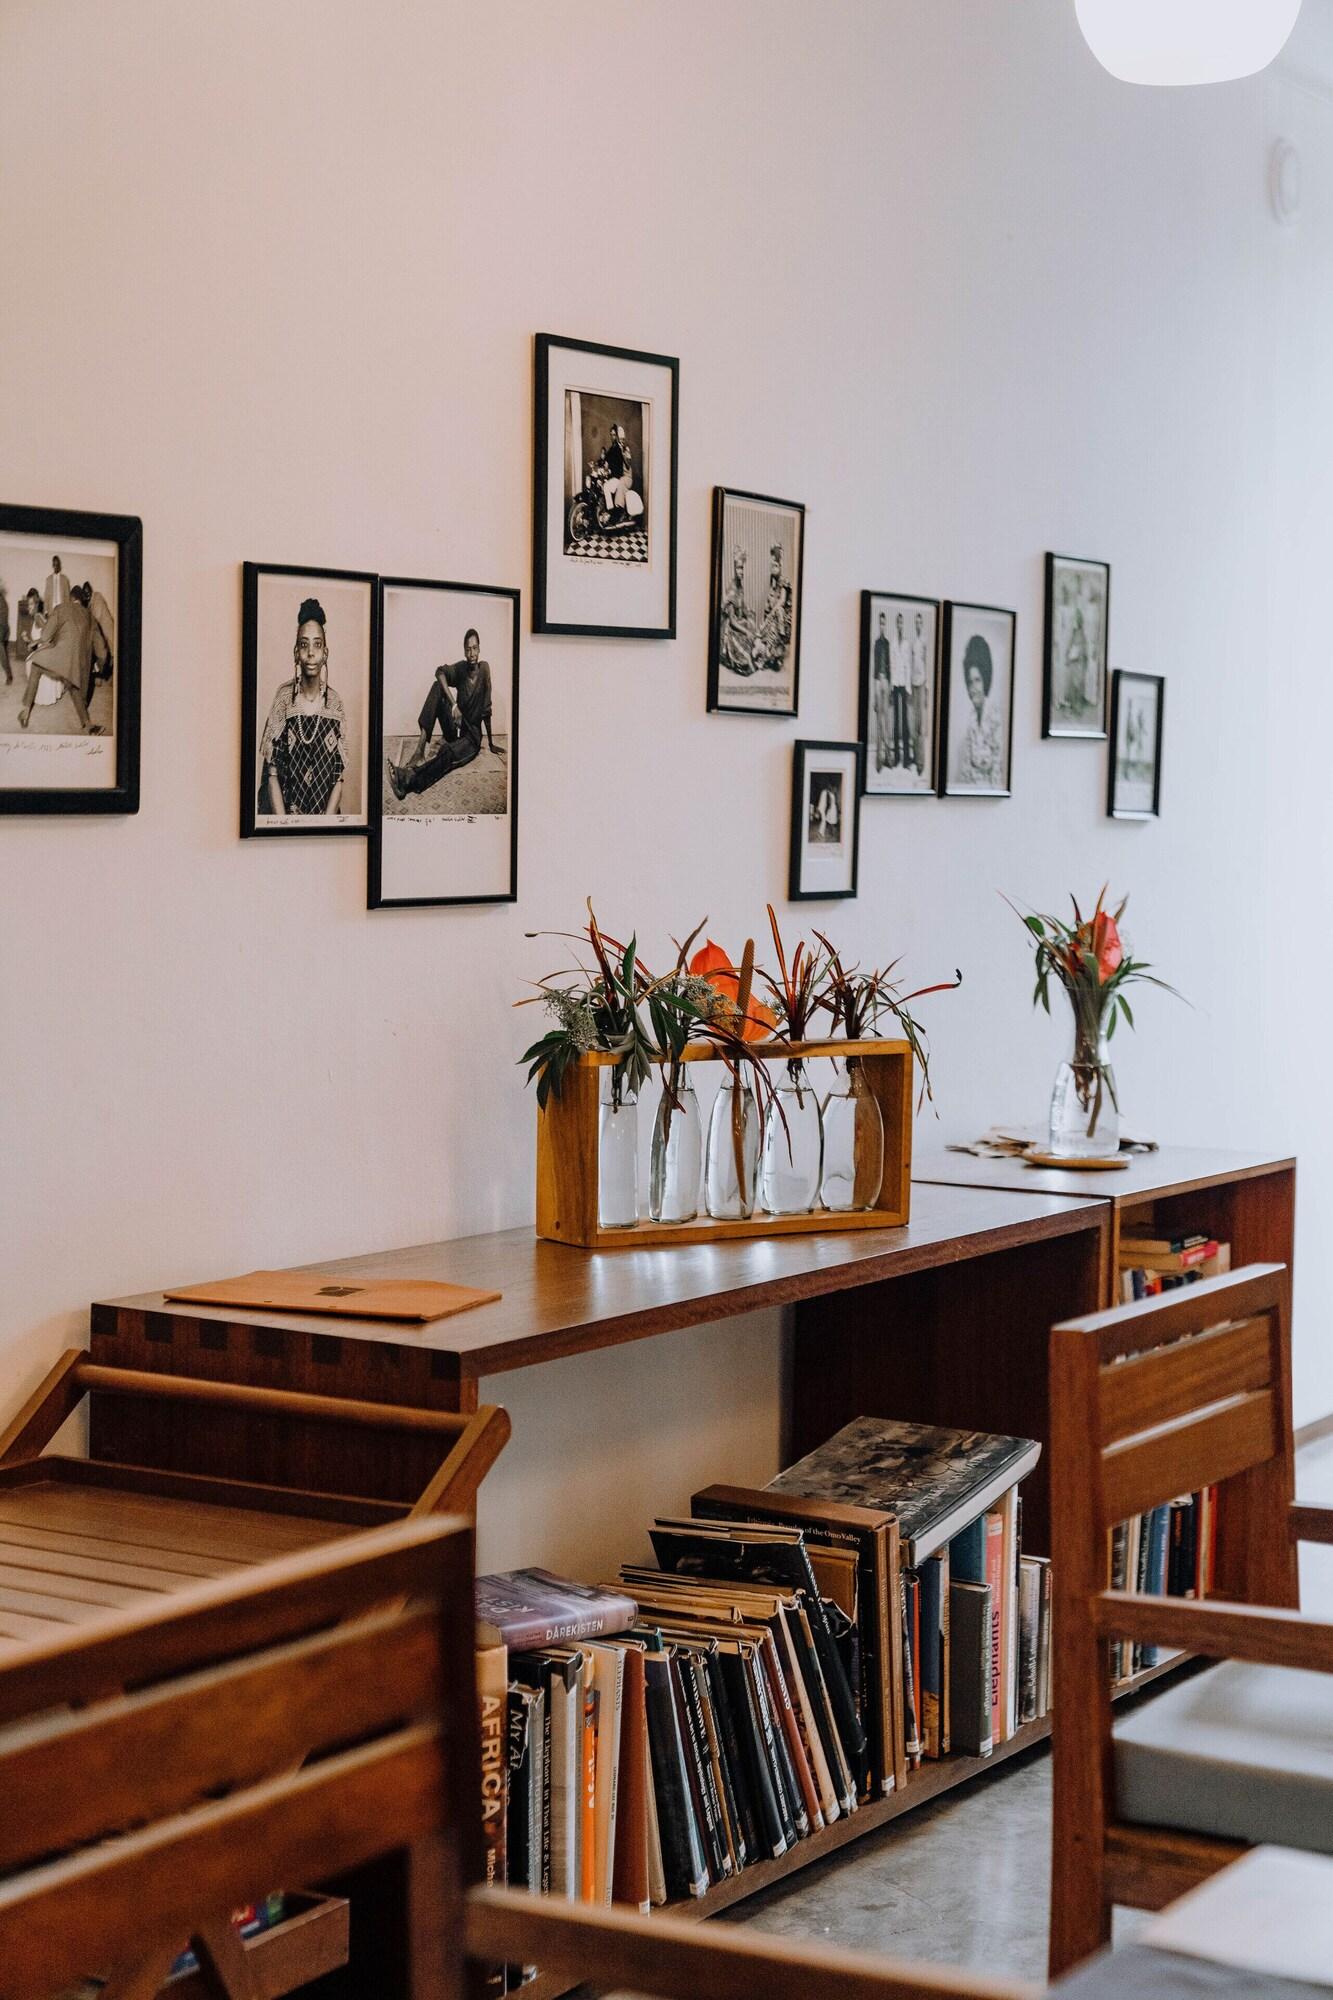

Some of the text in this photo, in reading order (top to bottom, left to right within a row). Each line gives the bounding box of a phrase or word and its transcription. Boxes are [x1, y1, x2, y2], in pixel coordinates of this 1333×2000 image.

[812, 1528, 824, 1537] the
[824, 1530, 841, 1540] Omo
[841, 1532, 861, 1545] Valley
[545, 1619, 603, 1641] DÅREKISTEN
[992, 1611, 1000, 1706] Elephants
[510, 1709, 523, 1742] MY
[481, 1696, 501, 1821] AFRICA
[543, 1739, 551, 1785] Elephant
[534, 1775, 542, 1819] Hotel
[543, 1788, 550, 1800] in
[534, 1823, 542, 1866] Book
[543, 1853, 550, 1864] &
[486, 1847, 497, 1889] Micha
[542, 1866, 550, 1897] Legen
